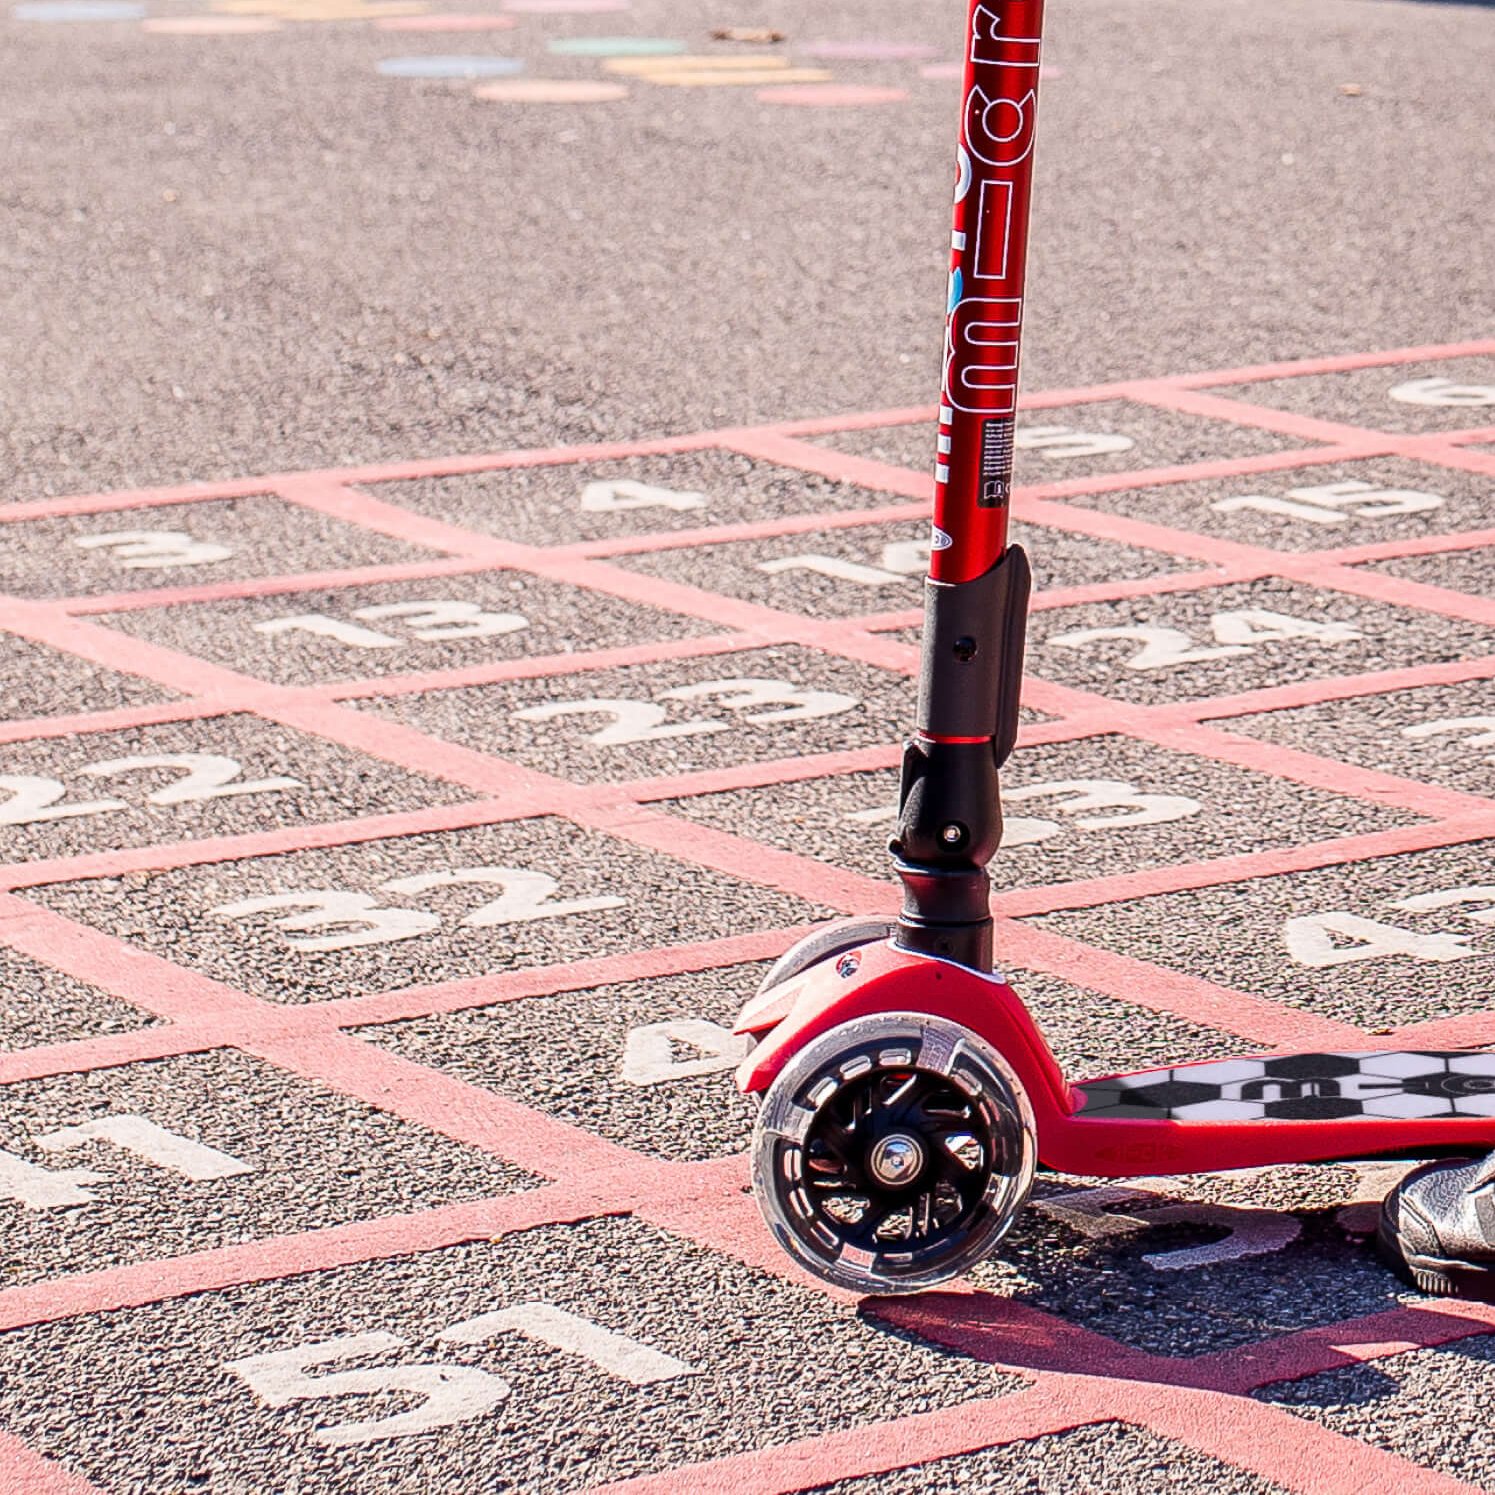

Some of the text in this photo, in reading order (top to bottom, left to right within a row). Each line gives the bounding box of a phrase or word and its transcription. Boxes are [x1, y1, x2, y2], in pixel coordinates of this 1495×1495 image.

[581, 479, 706, 511] 4
[1209, 479, 1447, 524] 15
[73, 530, 233, 570] 3
[253, 599, 531, 649] 13
[1048, 607, 1365, 671] 24
[508, 678, 862, 746] 23
[212, 866, 627, 953] 32
[223, 1300, 705, 1446] 51
